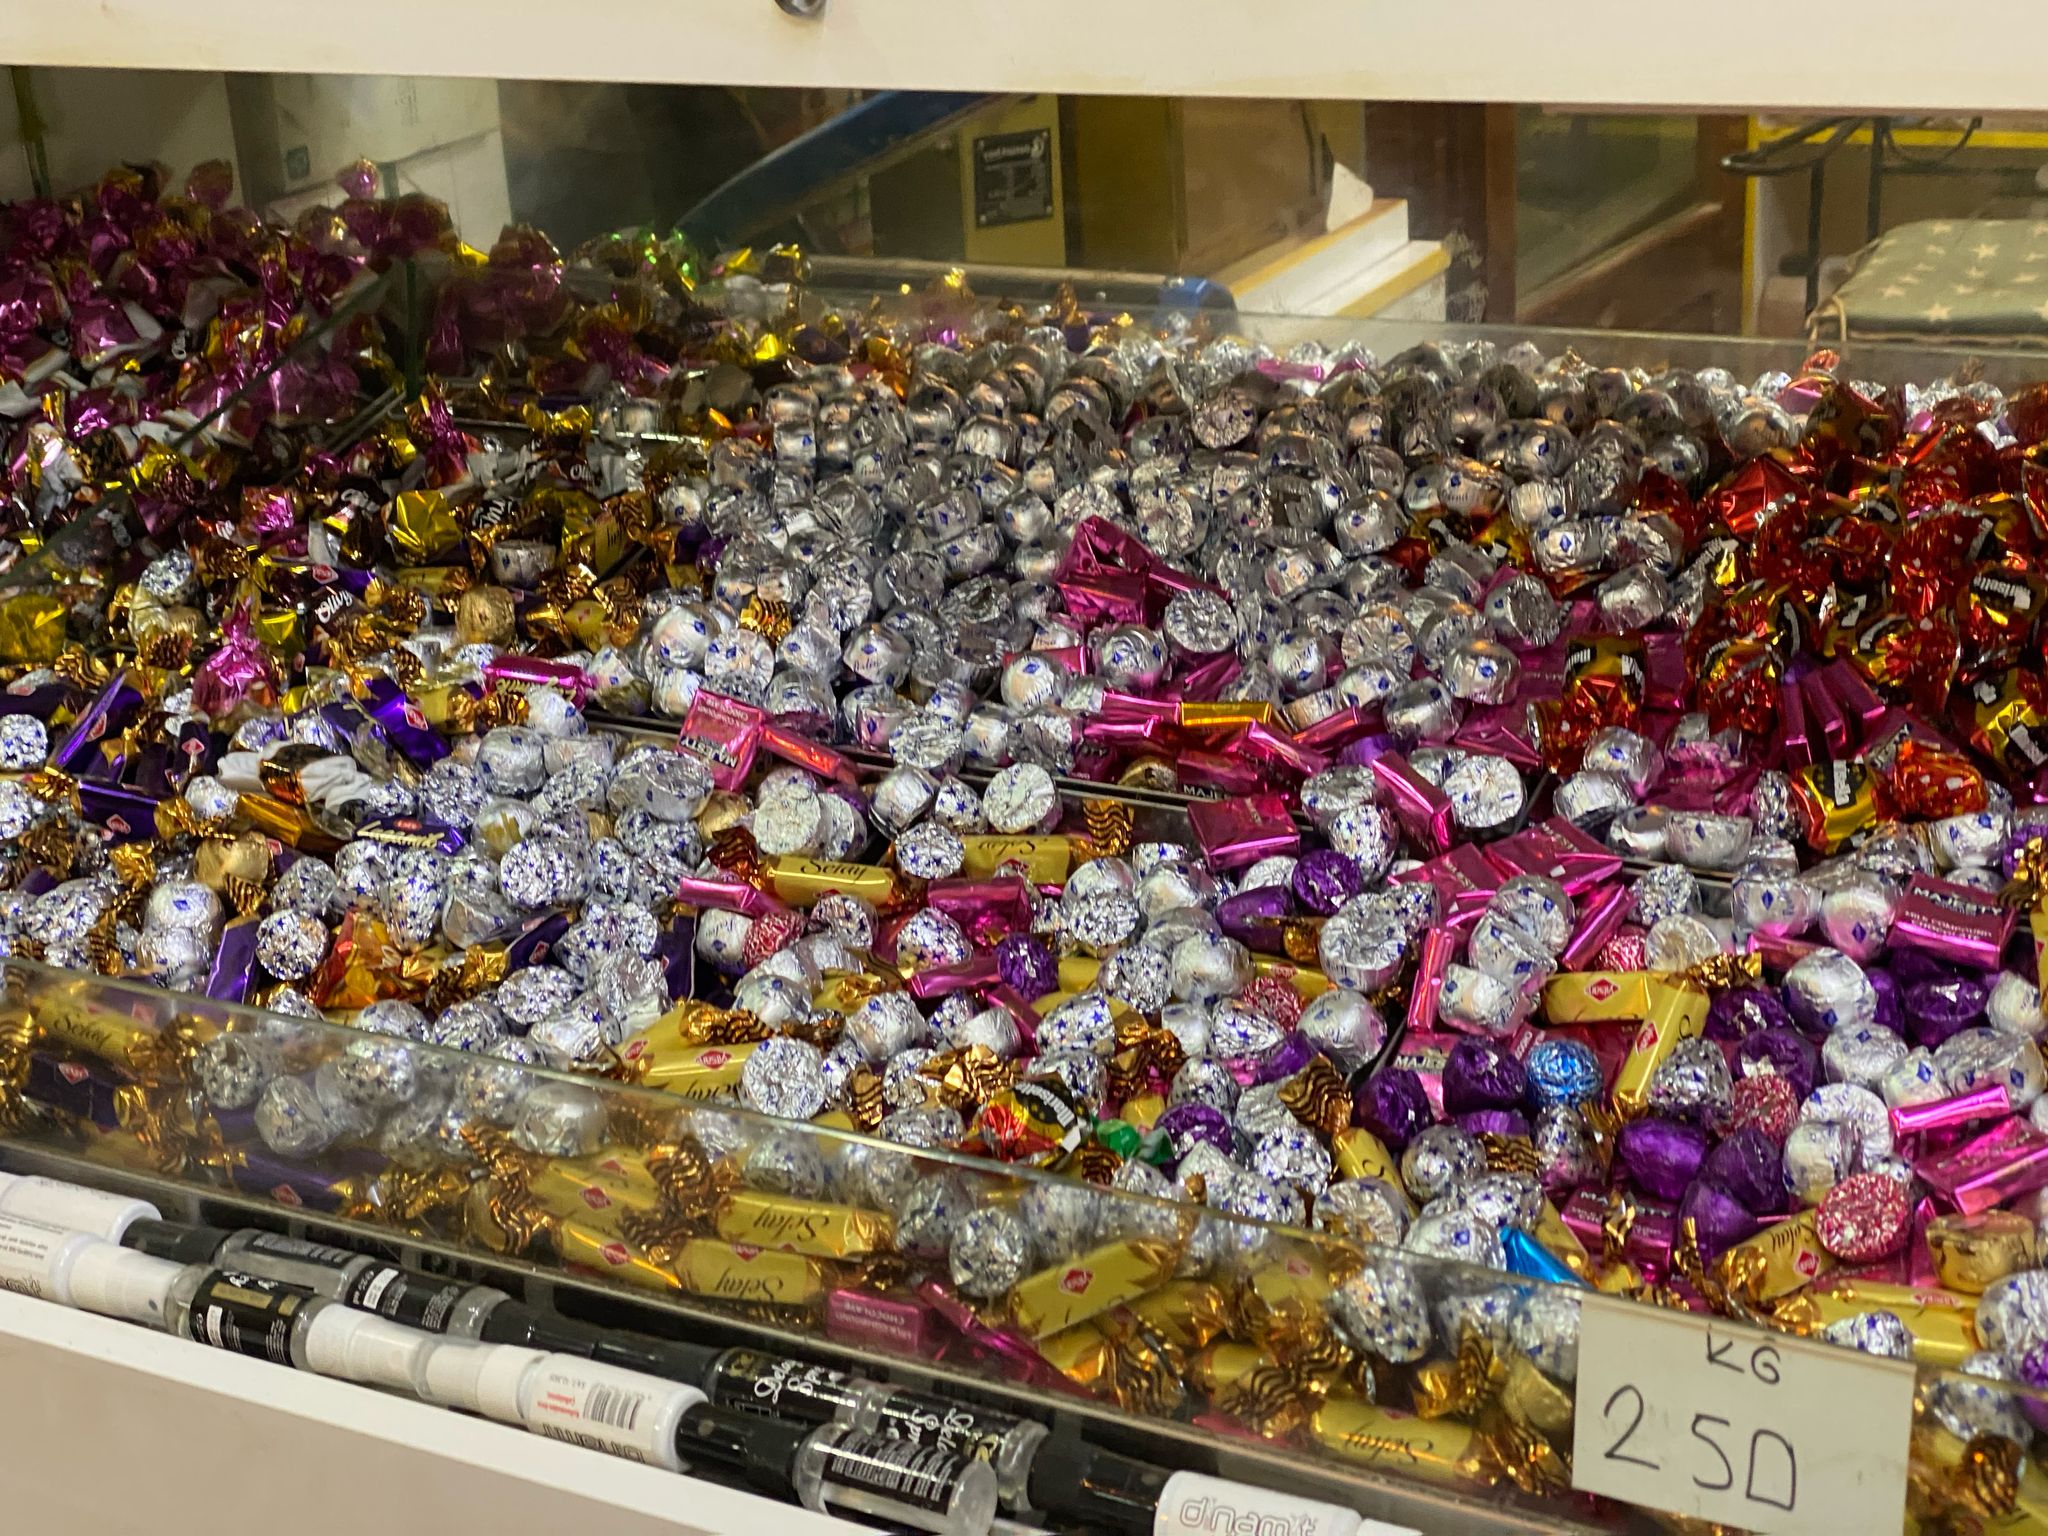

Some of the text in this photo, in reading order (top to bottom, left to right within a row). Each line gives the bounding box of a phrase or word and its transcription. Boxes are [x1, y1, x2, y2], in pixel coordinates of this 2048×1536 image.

[753, 1211, 831, 1236] Selay
[713, 1267, 787, 1301] Selay
[1705, 1322, 1781, 1385] KG
